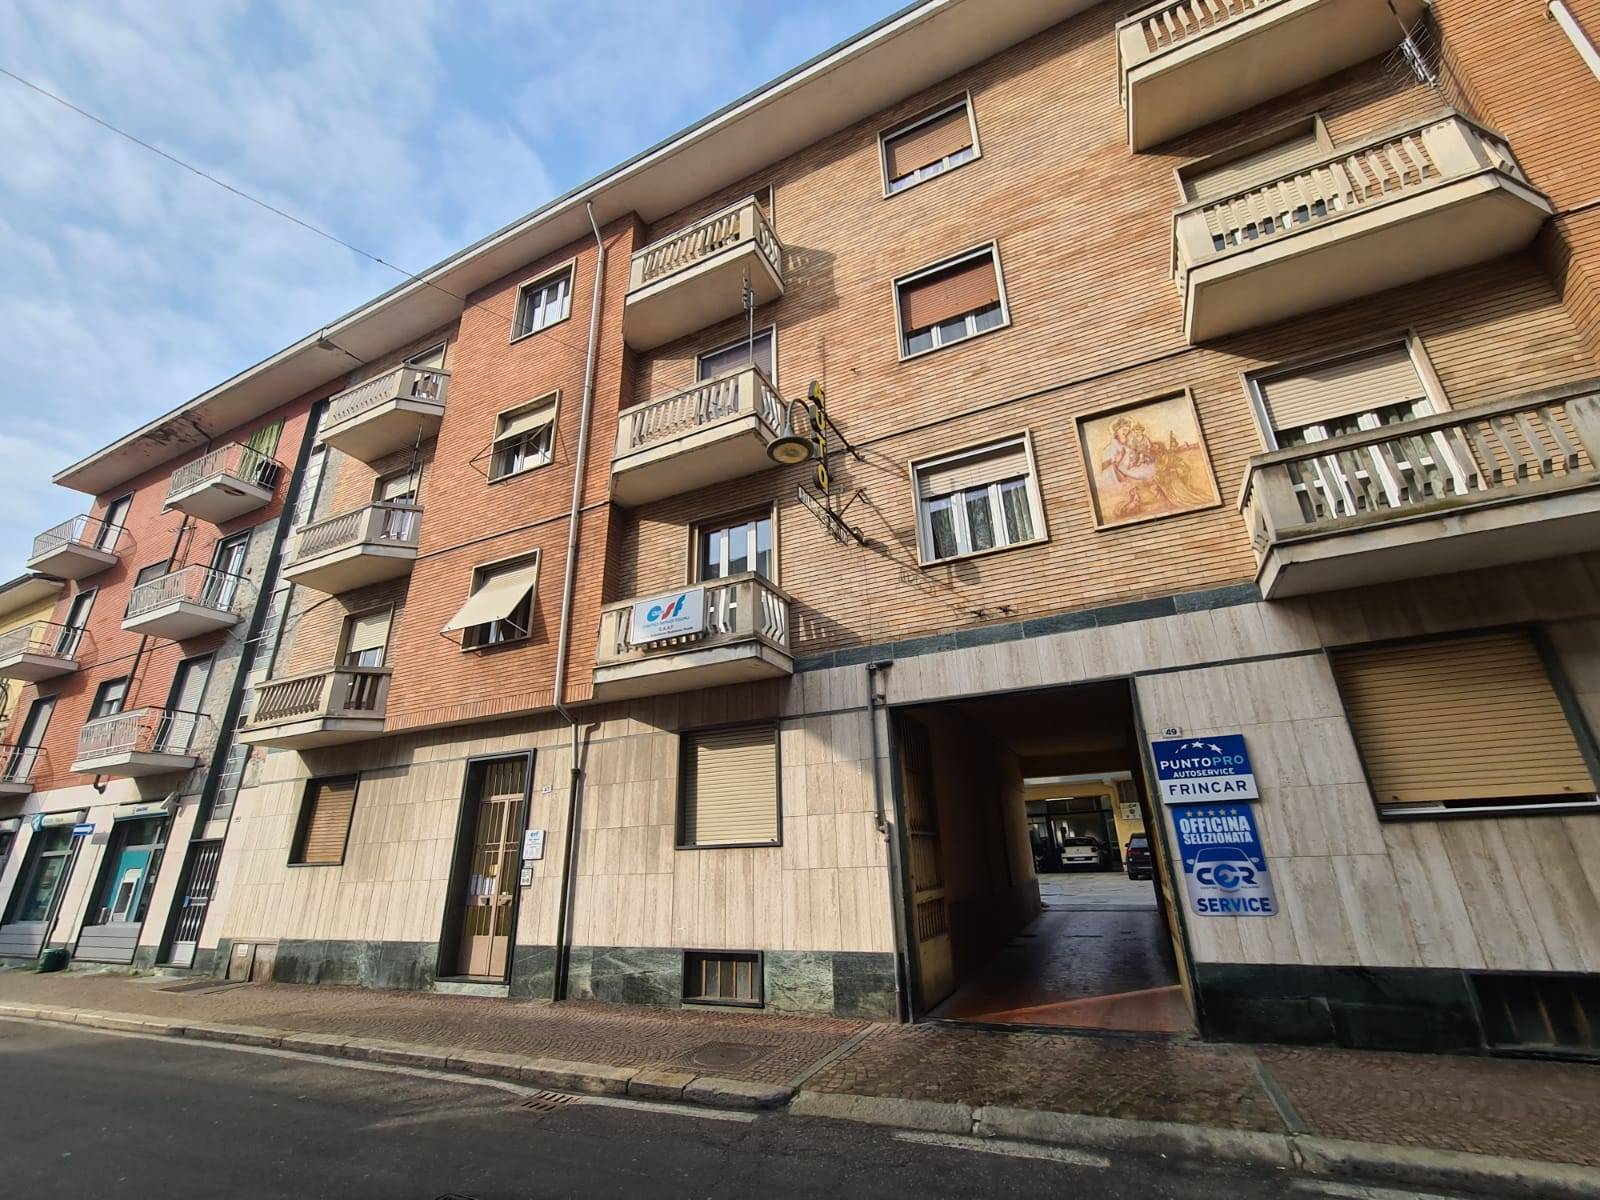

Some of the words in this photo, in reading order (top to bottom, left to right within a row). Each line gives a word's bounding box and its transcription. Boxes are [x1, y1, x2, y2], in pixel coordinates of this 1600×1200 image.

[1160, 754, 1244, 770] PUNTOPRO
[1173, 767, 1235, 778] AUTOSERVICE
[1169, 780, 1248, 796] FRINCAR
[1179, 815, 1251, 834] OFFICINA
[1183, 831, 1254, 845] SELEZIONATA
[1197, 897, 1272, 912] SERVICE
